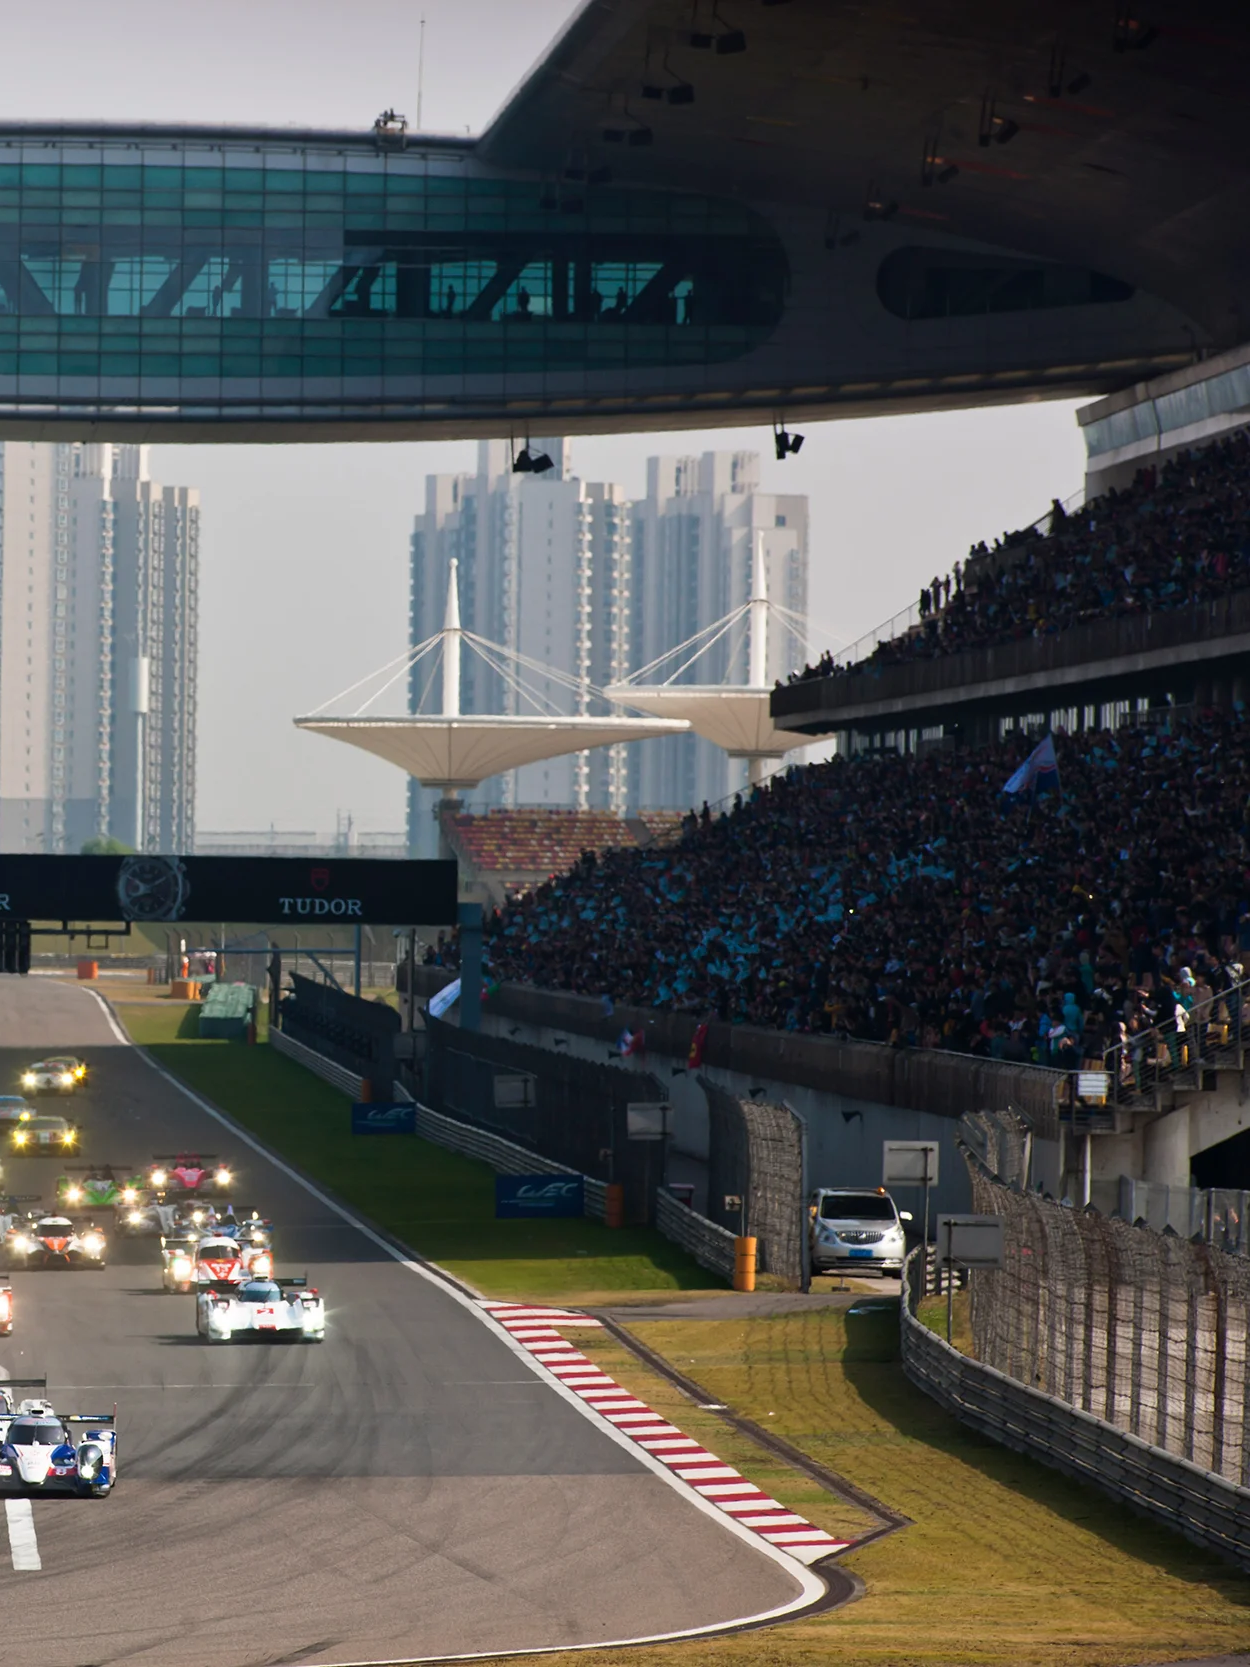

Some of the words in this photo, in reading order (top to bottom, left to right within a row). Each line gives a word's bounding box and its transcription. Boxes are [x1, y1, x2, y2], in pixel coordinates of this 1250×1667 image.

[279, 898, 363, 916] TUDOR
[367, 1108, 414, 1120] WEC
[516, 1182, 578, 1198] WEC
